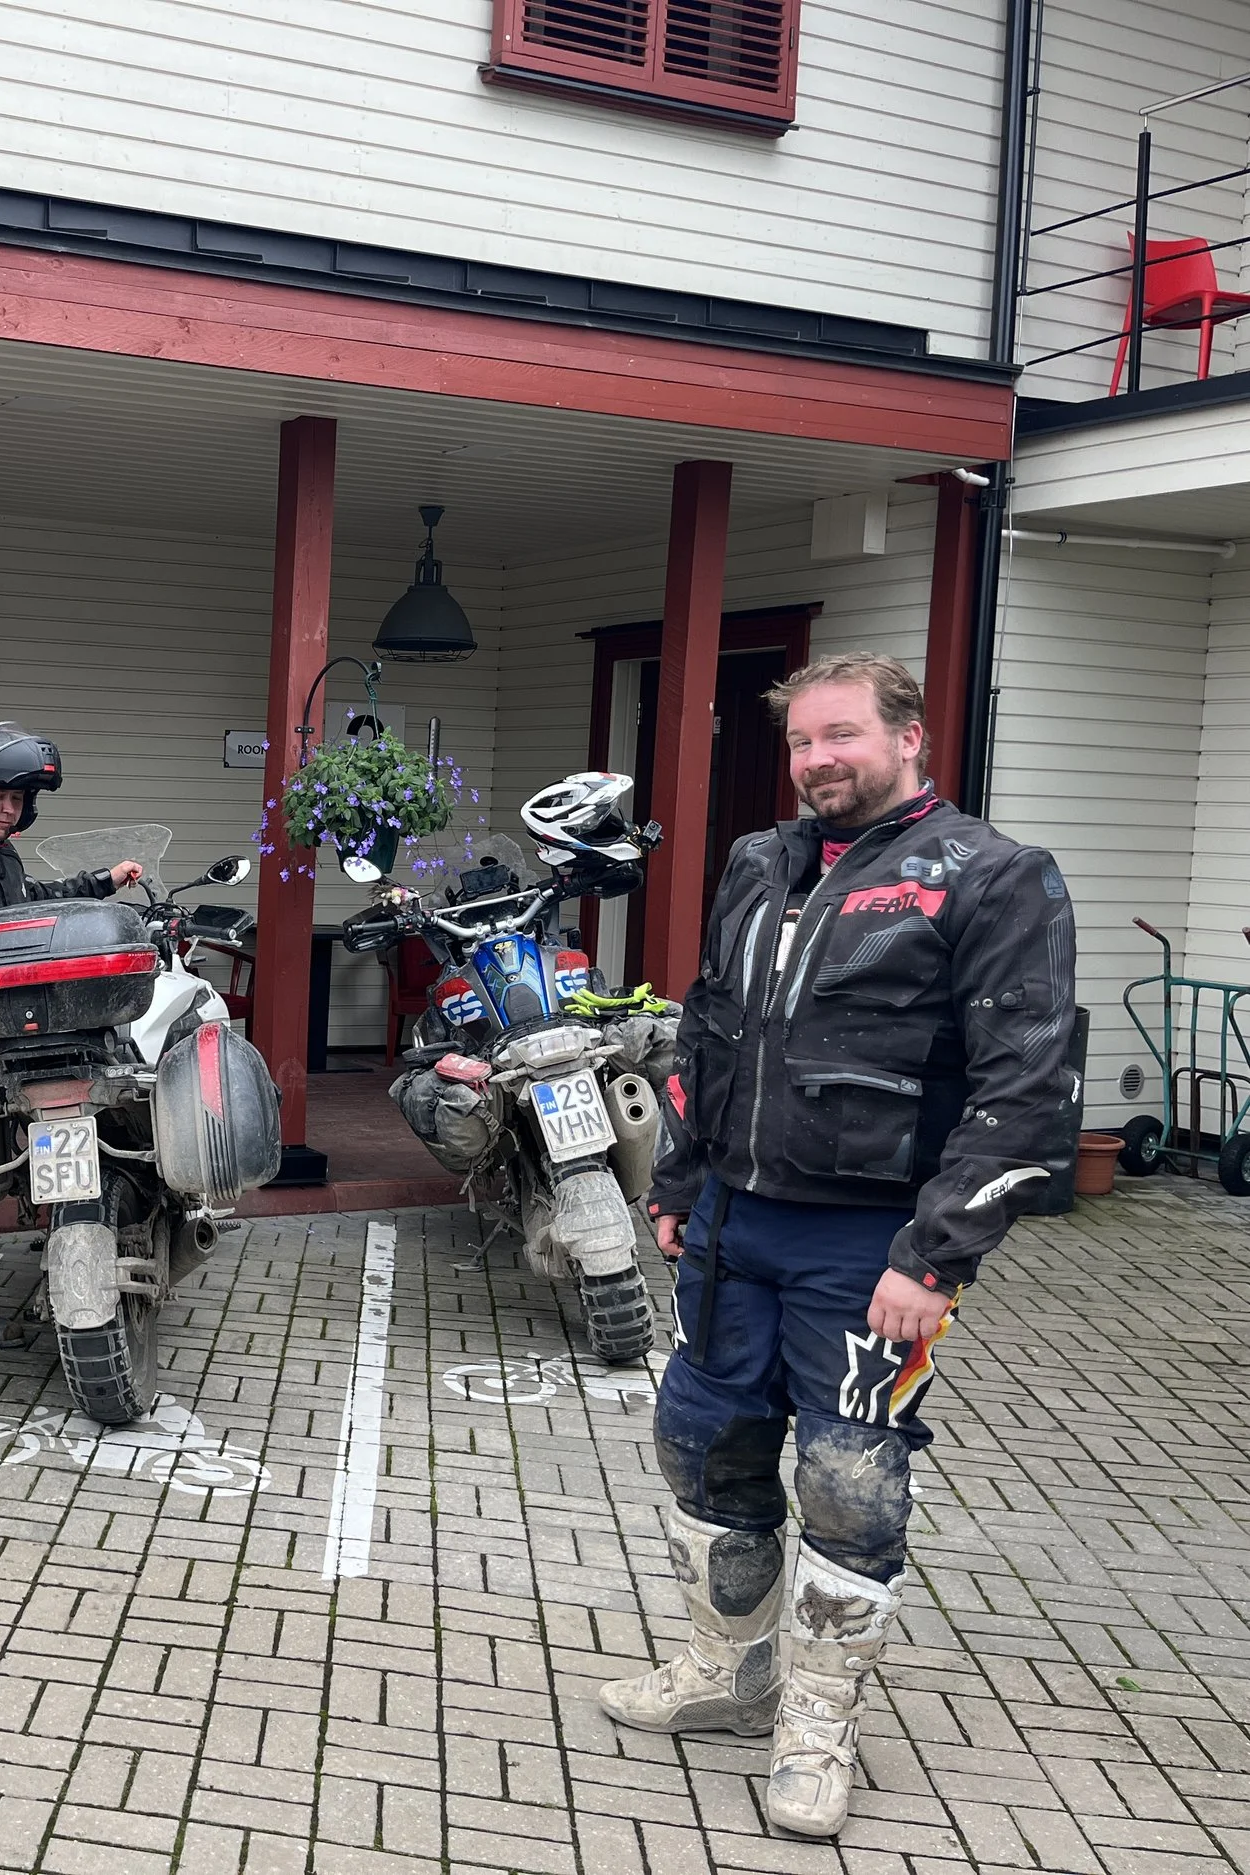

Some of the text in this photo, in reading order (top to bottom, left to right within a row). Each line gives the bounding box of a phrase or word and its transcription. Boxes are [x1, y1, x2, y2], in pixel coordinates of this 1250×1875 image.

[441, 989, 483, 1027] GS
[540, 1079, 594, 1112] FIN 29
[54, 1126, 91, 1158] 22
[547, 1107, 606, 1144] VHN
[37, 1160, 93, 1194] SFU
